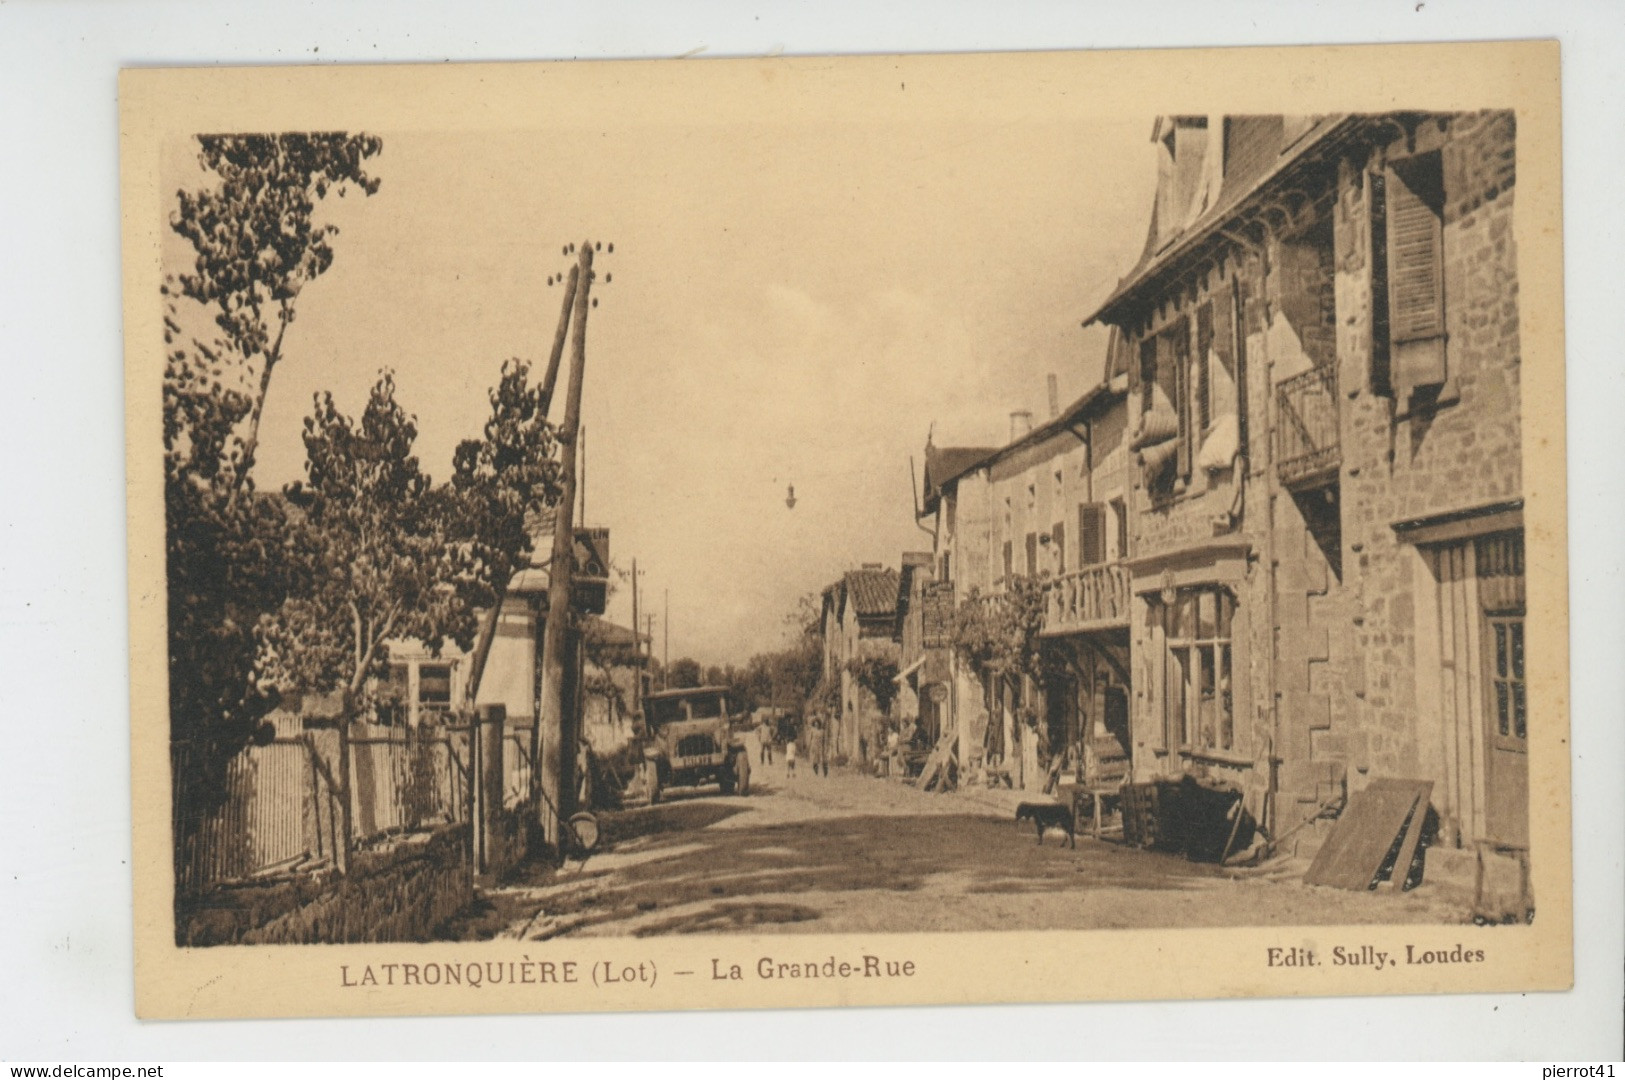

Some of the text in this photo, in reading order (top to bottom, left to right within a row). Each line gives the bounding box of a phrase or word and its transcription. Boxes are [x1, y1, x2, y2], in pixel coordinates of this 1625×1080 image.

[341, 955, 577, 988] LATRONQUIÈRE
[593, 961, 656, 987] (Lot)
[712, 959, 743, 980] La
[758, 956, 915, 979] Grande-Rue
[1267, 944, 1484, 970] Edit. Sully, Loudes
